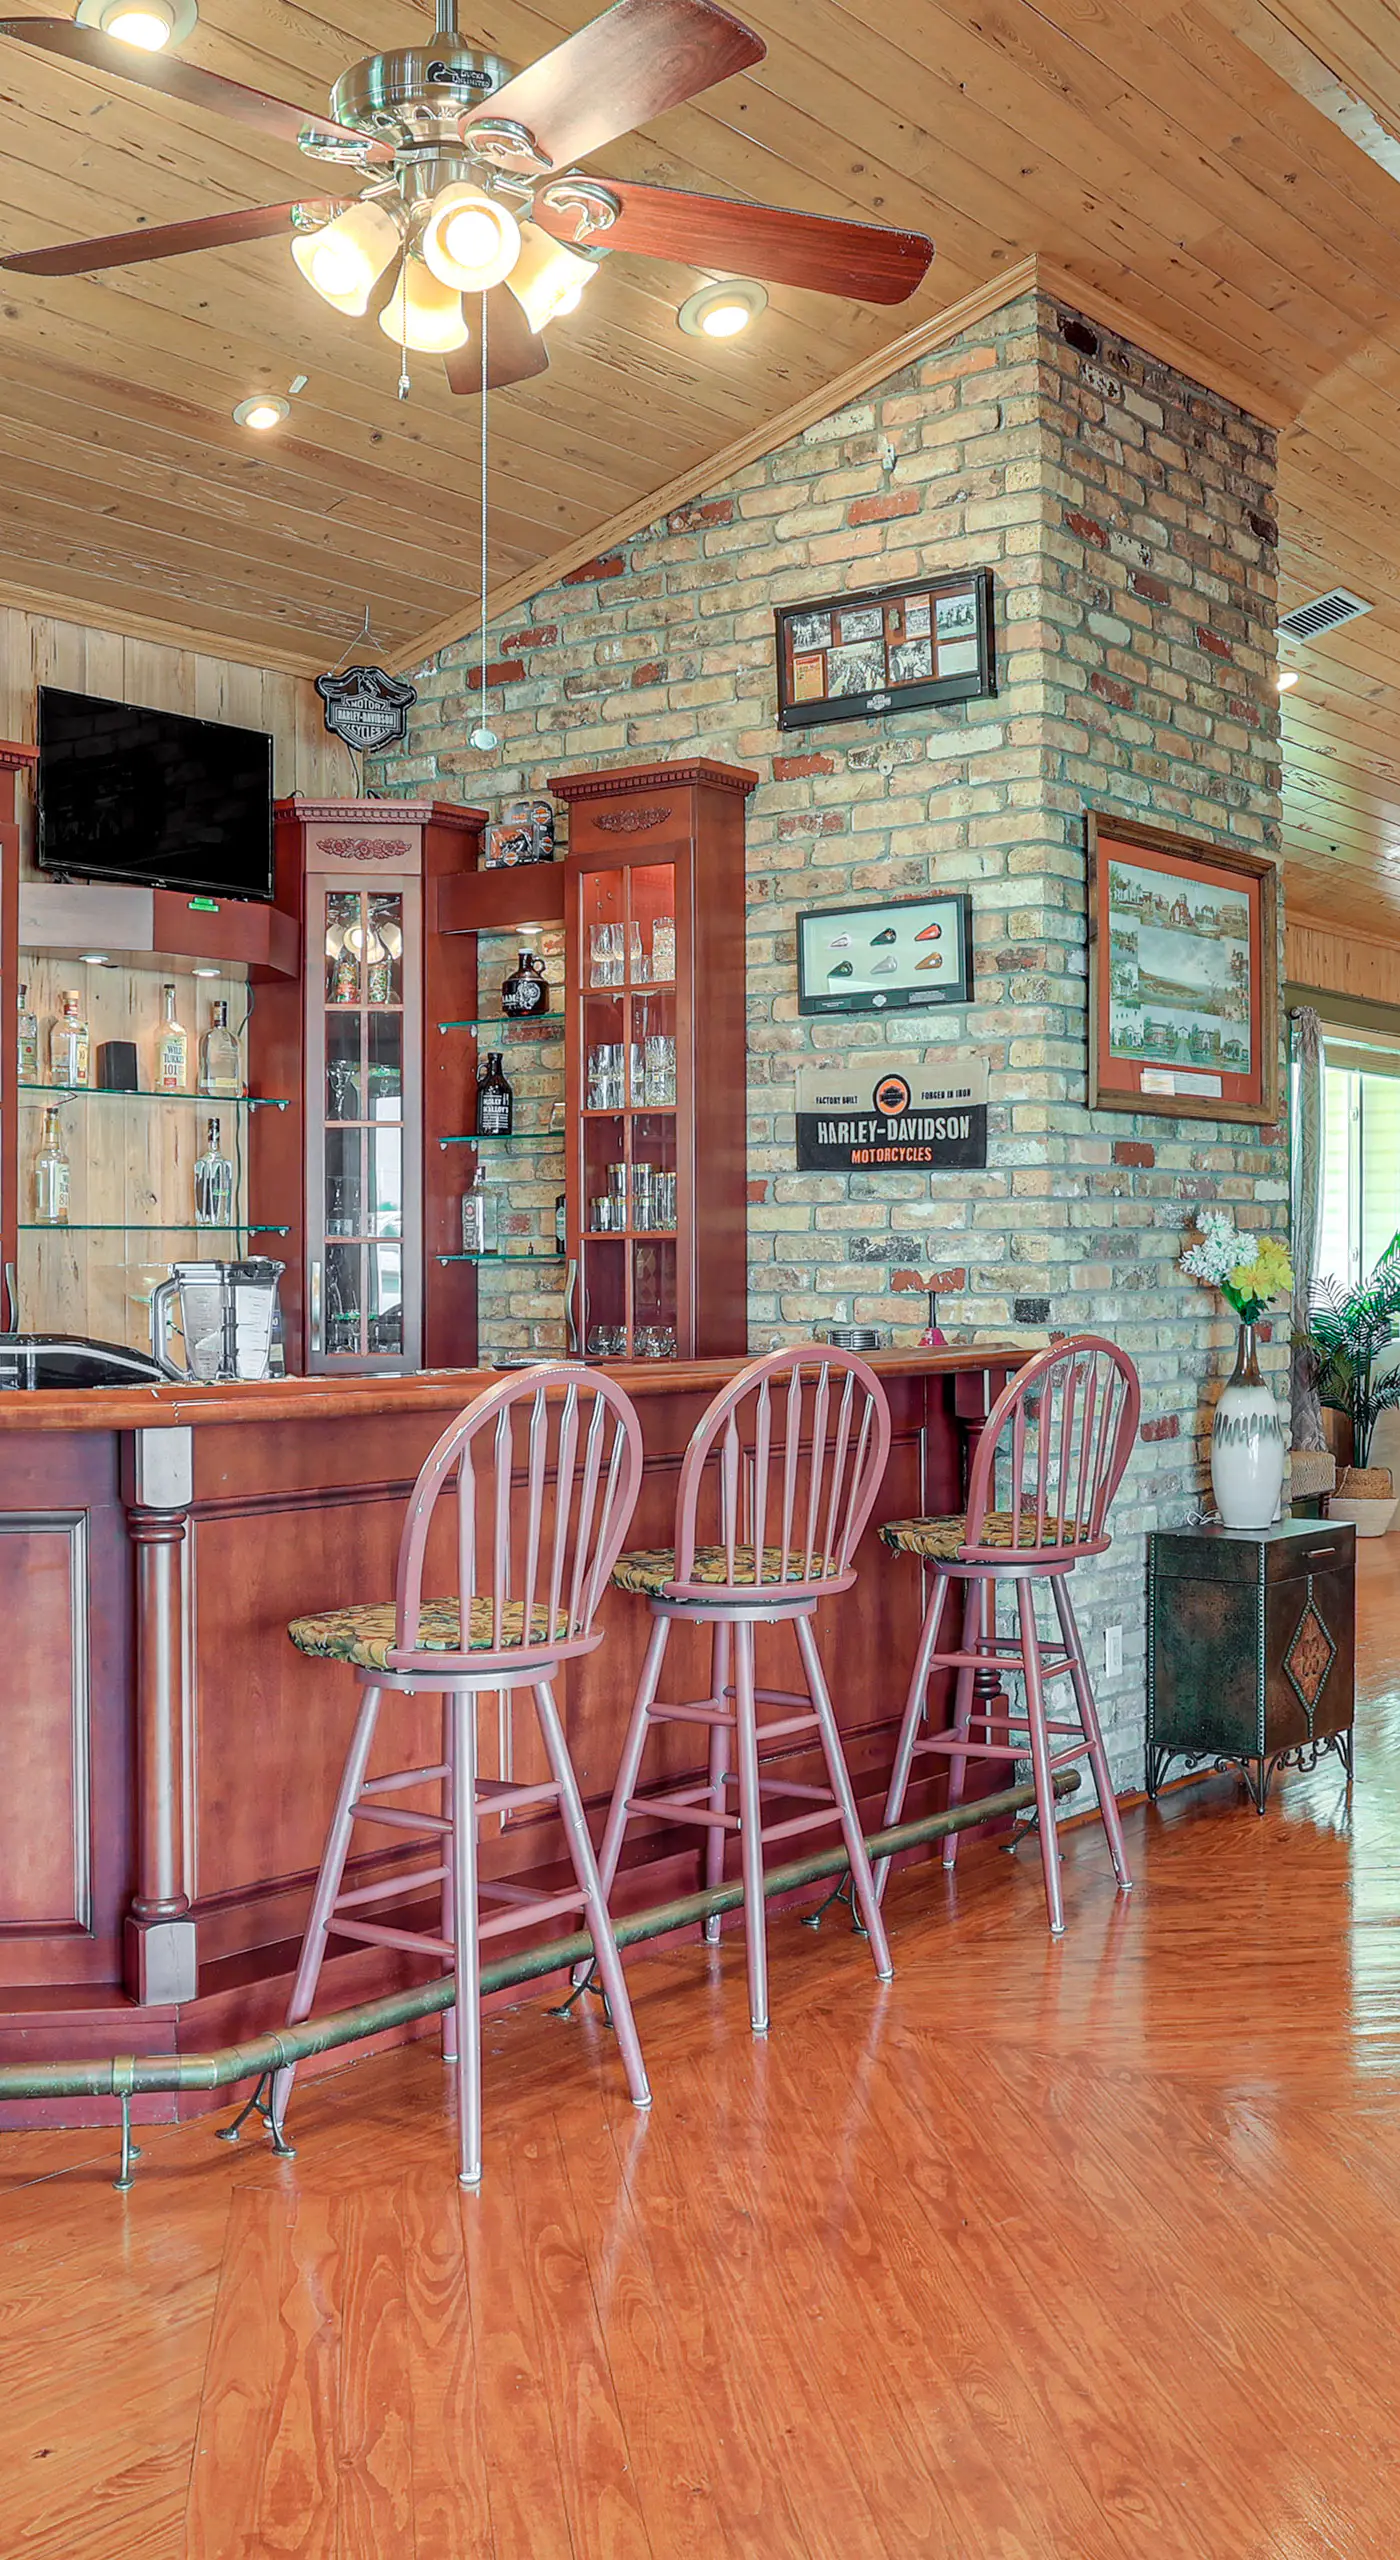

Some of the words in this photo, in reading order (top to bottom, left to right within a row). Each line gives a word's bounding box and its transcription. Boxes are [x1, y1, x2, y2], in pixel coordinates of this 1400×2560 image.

[350, 698, 382, 711] MOTOR
[337, 709, 394, 724] HARLEY-DAVIDSON
[351, 725, 381, 739] CYCLES
[167, 1045, 182, 1054] WILD
[163, 1064, 177, 1075] 101
[815, 1096, 841, 1105] FACTORY
[841, 1095, 858, 1104] BUILT
[921, 1090, 945, 1100] FORGED
[946, 1089, 955, 1099] IN
[956, 1088, 971, 1098] IRON
[817, 1115, 970, 1144] HARLEY-DAVIDSON
[851, 1146, 932, 1164] MOTORCYCLES
